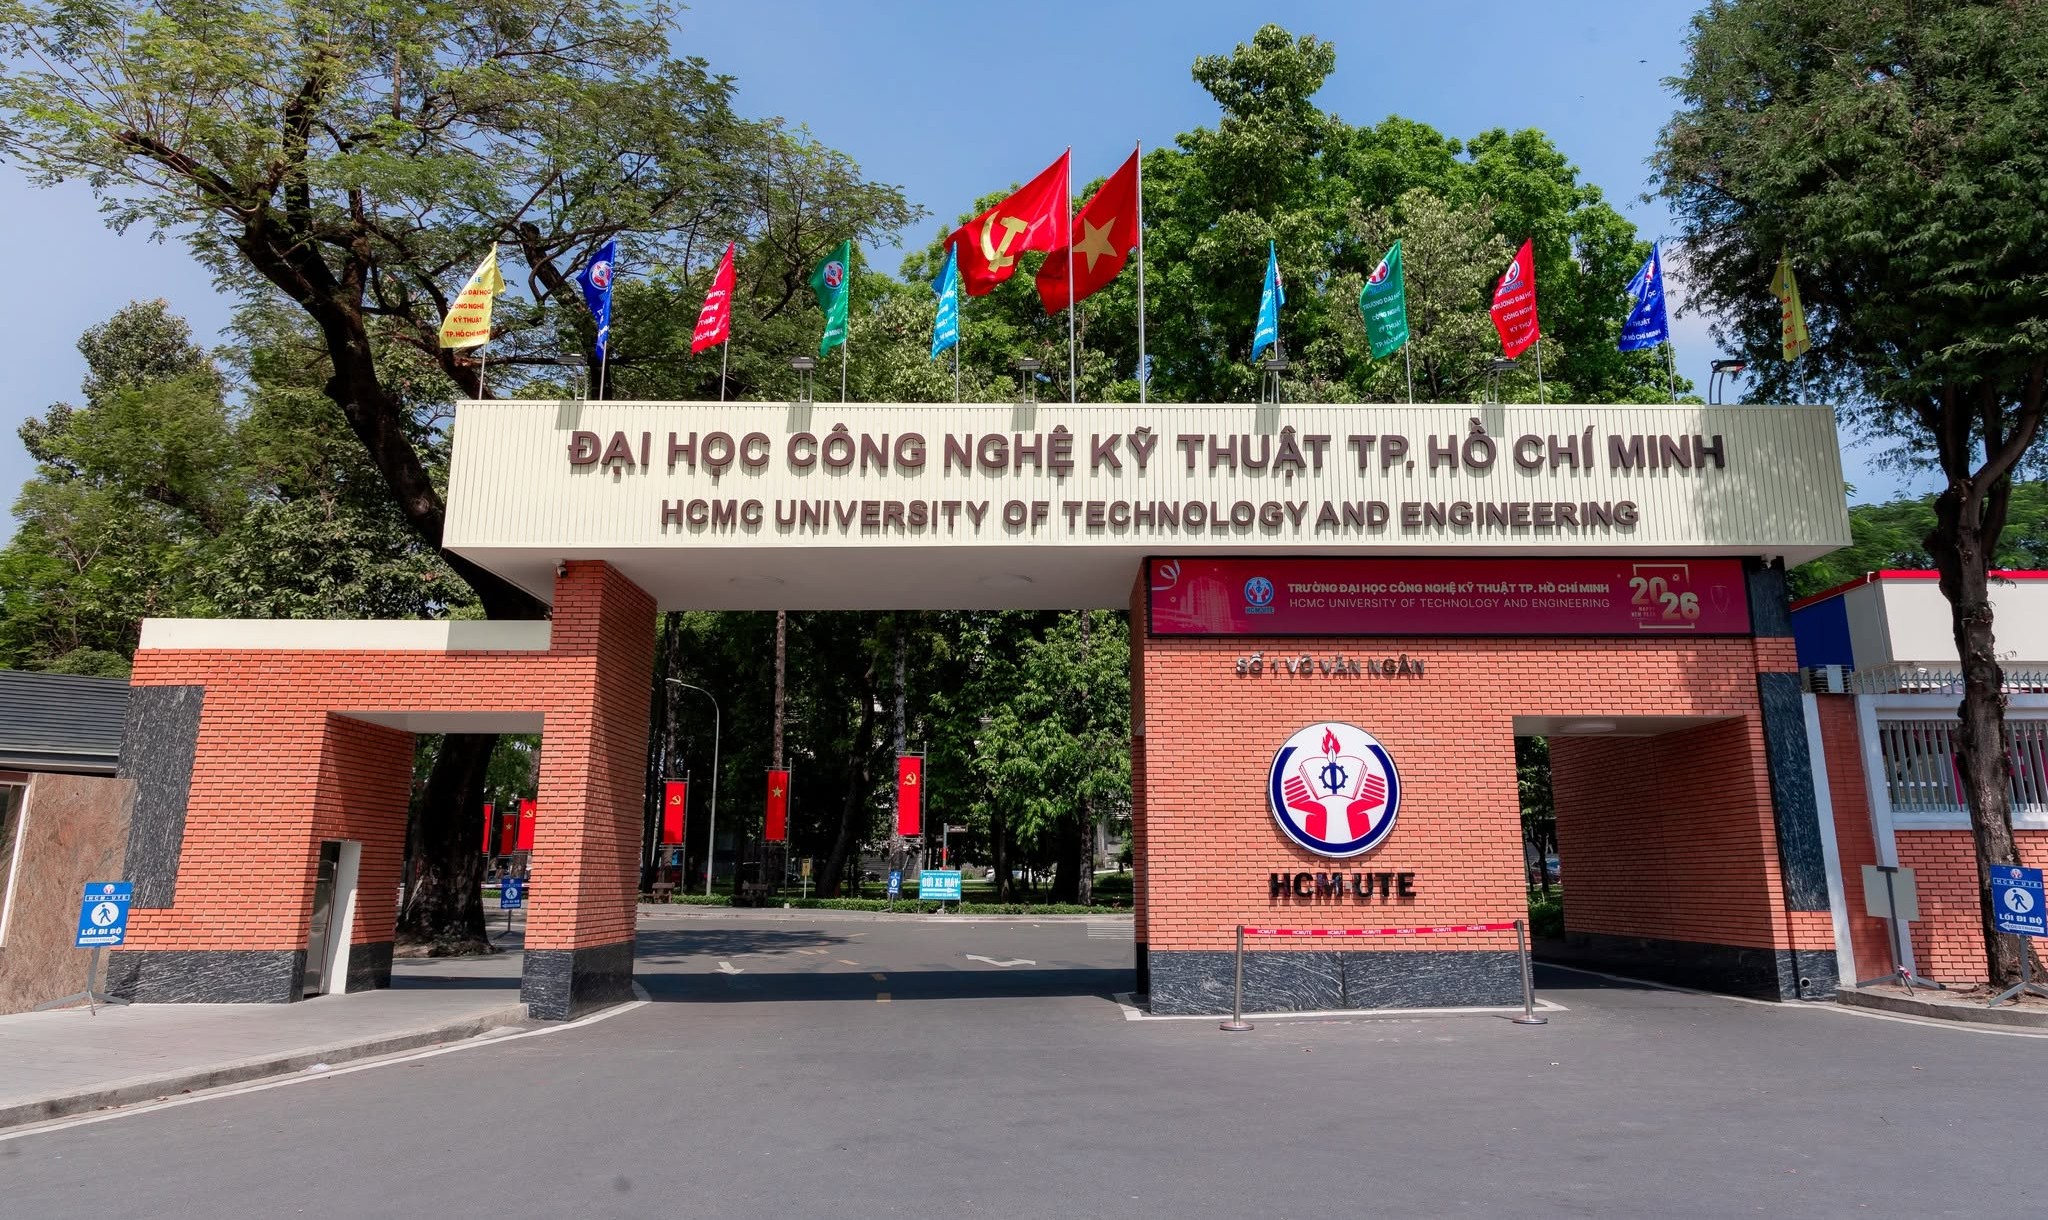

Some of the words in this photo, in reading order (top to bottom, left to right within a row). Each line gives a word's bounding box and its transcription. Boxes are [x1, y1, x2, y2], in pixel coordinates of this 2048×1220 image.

[568, 431, 652, 474] ĐẠI
[668, 432, 770, 476] HỌC
[787, 423, 926, 467] CÔNG
[944, 425, 1074, 476] NGHỆ
[1091, 426, 1159, 469] KỸ
[1177, 425, 1331, 477] THUẬT
[1348, 434, 1415, 469] TP.
[1428, 417, 1496, 469] HỒ
[1514, 425, 1595, 469] CHÍ
[1608, 434, 1725, 469] MINH
[661, 499, 764, 526] HCMC
[775, 499, 990, 526] UNIVERSITY
[1003, 500, 1050, 526] OF
[1063, 500, 1308, 526] TECHNOLOGY
[1316, 500, 1390, 526] AND
[1400, 500, 1639, 526] ENGINEERING
[1288, 582, 1338, 593] TRƯỜNG
[1339, 583, 1360, 595] ĐẠI
[1362, 583, 1388, 595] HỌC
[1390, 581, 1423, 593] CÔNG
[1425, 581, 1456, 595] NGHỆ
[1458, 581, 1474, 593] KỸ
[1477, 581, 1516, 595] THUẬT
[1518, 583, 1537, 593] TP.
[1539, 581, 1554, 593] HỒ
[1558, 581, 1577, 593] CHÍ
[1579, 583, 1610, 593] MINH
[1290, 599, 1325, 608] HCMC
[1329, 599, 1396, 608] UNIVERSITY
[1401, 599, 1415, 608] OF
[1420, 599, 1499, 608] TECHNOLOGY
[1504, 599, 1528, 608] AND
[1532, 599, 1610, 608] ENGINEERING
[1236, 650, 1264, 673] SỐ
[1270, 658, 1279, 673] 1
[1285, 653, 1314, 673] VÕ
[1319, 653, 1361, 673] VĂN
[1368, 653, 1425, 673] NGÂN
[1999, 912, 2014, 921] LỐI
[2029, 917, 2042, 925] BỘ
[81, 927, 96, 935] LỐI
[110, 926, 122, 935] BỘ
